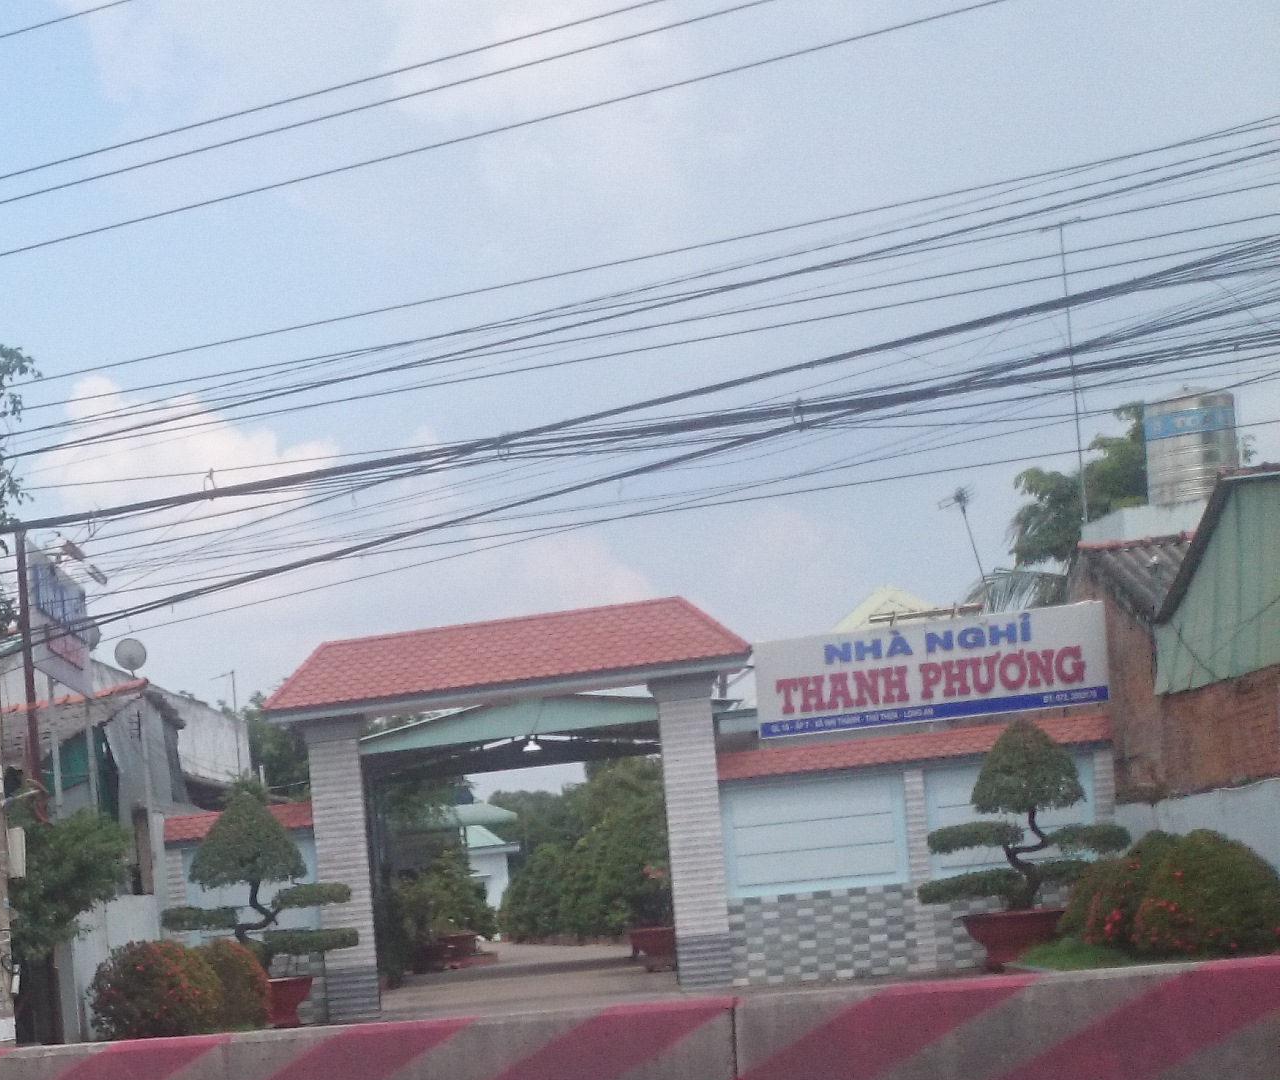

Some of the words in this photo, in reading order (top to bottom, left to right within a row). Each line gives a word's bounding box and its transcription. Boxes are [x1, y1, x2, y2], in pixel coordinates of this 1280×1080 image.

[823, 630, 914, 665] NHÀ
[925, 612, 1032, 655] NGHỈ
[776, 665, 910, 714] THANH
[919, 645, 1086, 700] PHƯƠNG
